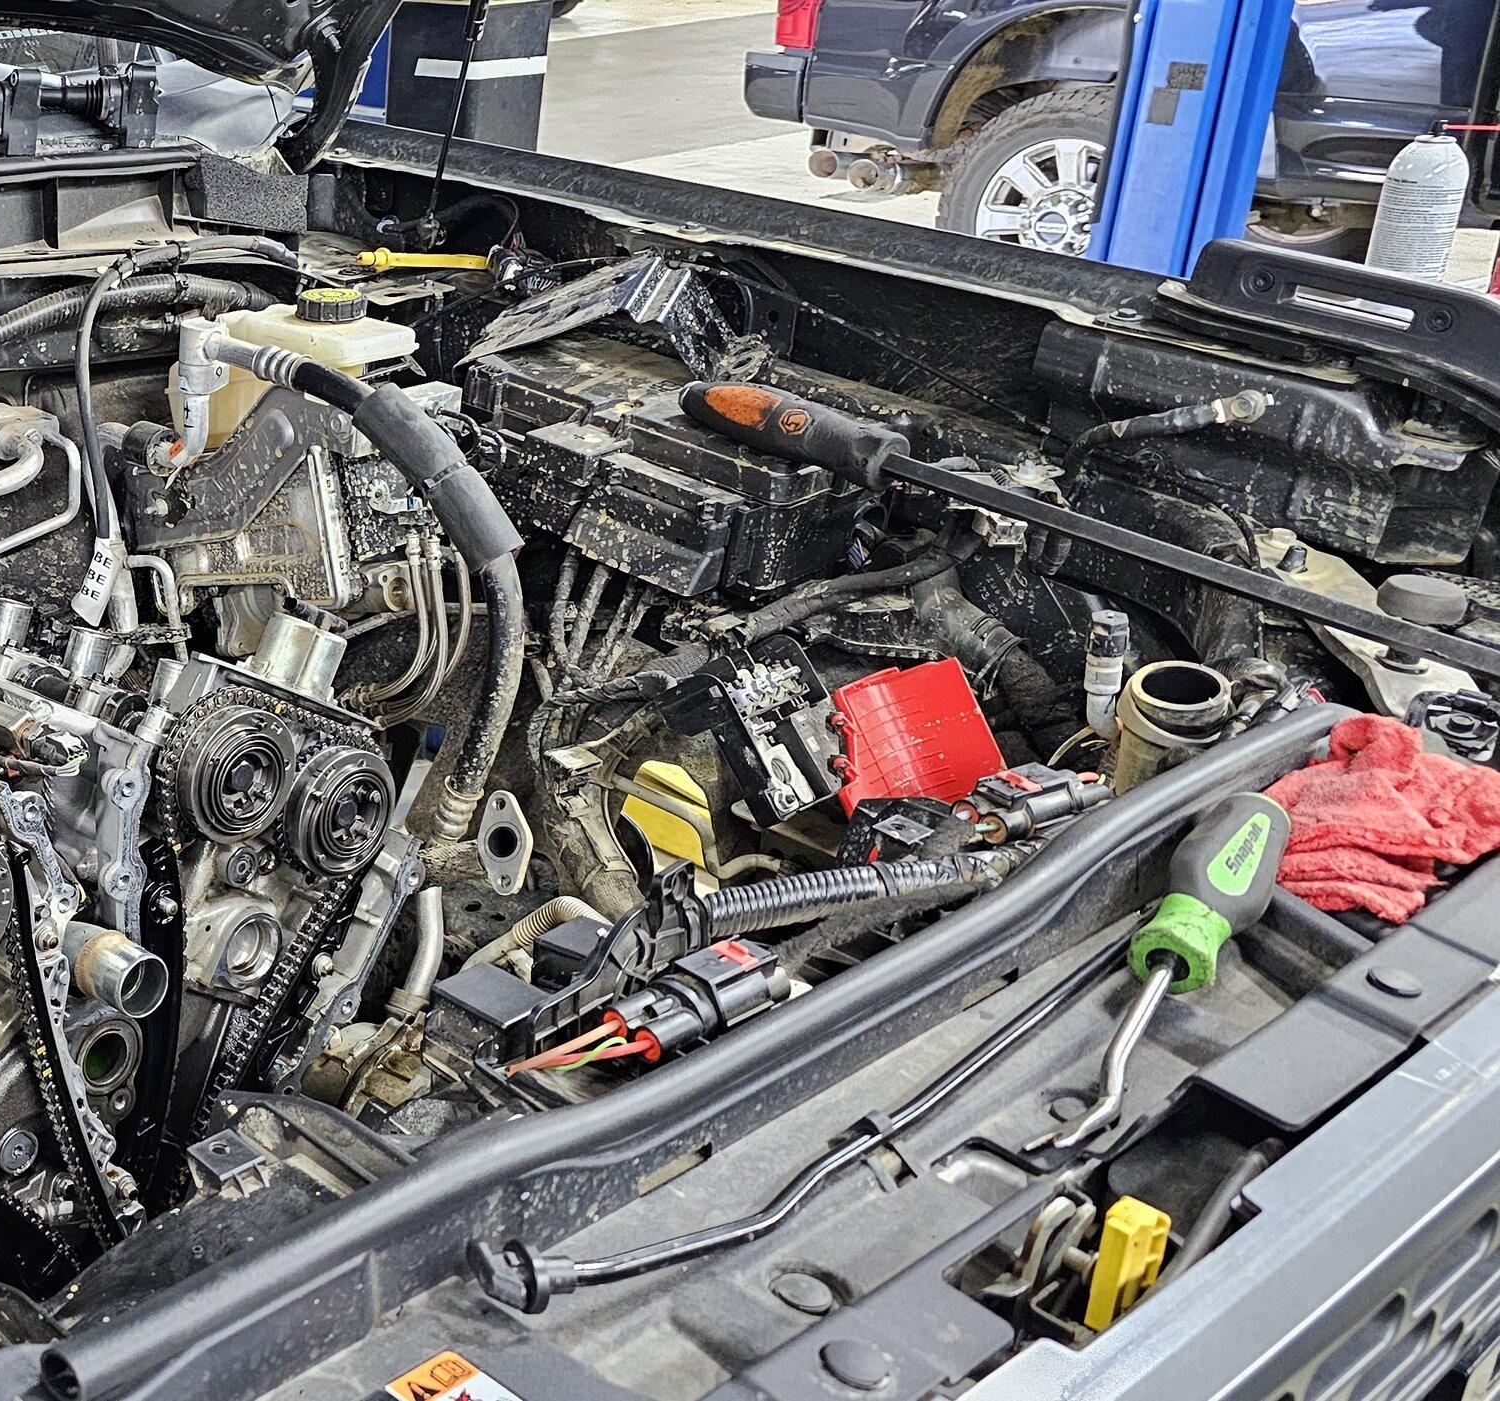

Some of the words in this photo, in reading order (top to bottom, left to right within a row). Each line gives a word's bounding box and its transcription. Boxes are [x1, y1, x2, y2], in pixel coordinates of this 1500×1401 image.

[94, 551, 113, 569] BE
[87, 568, 107, 585] BE
[80, 585, 101, 601] BE
